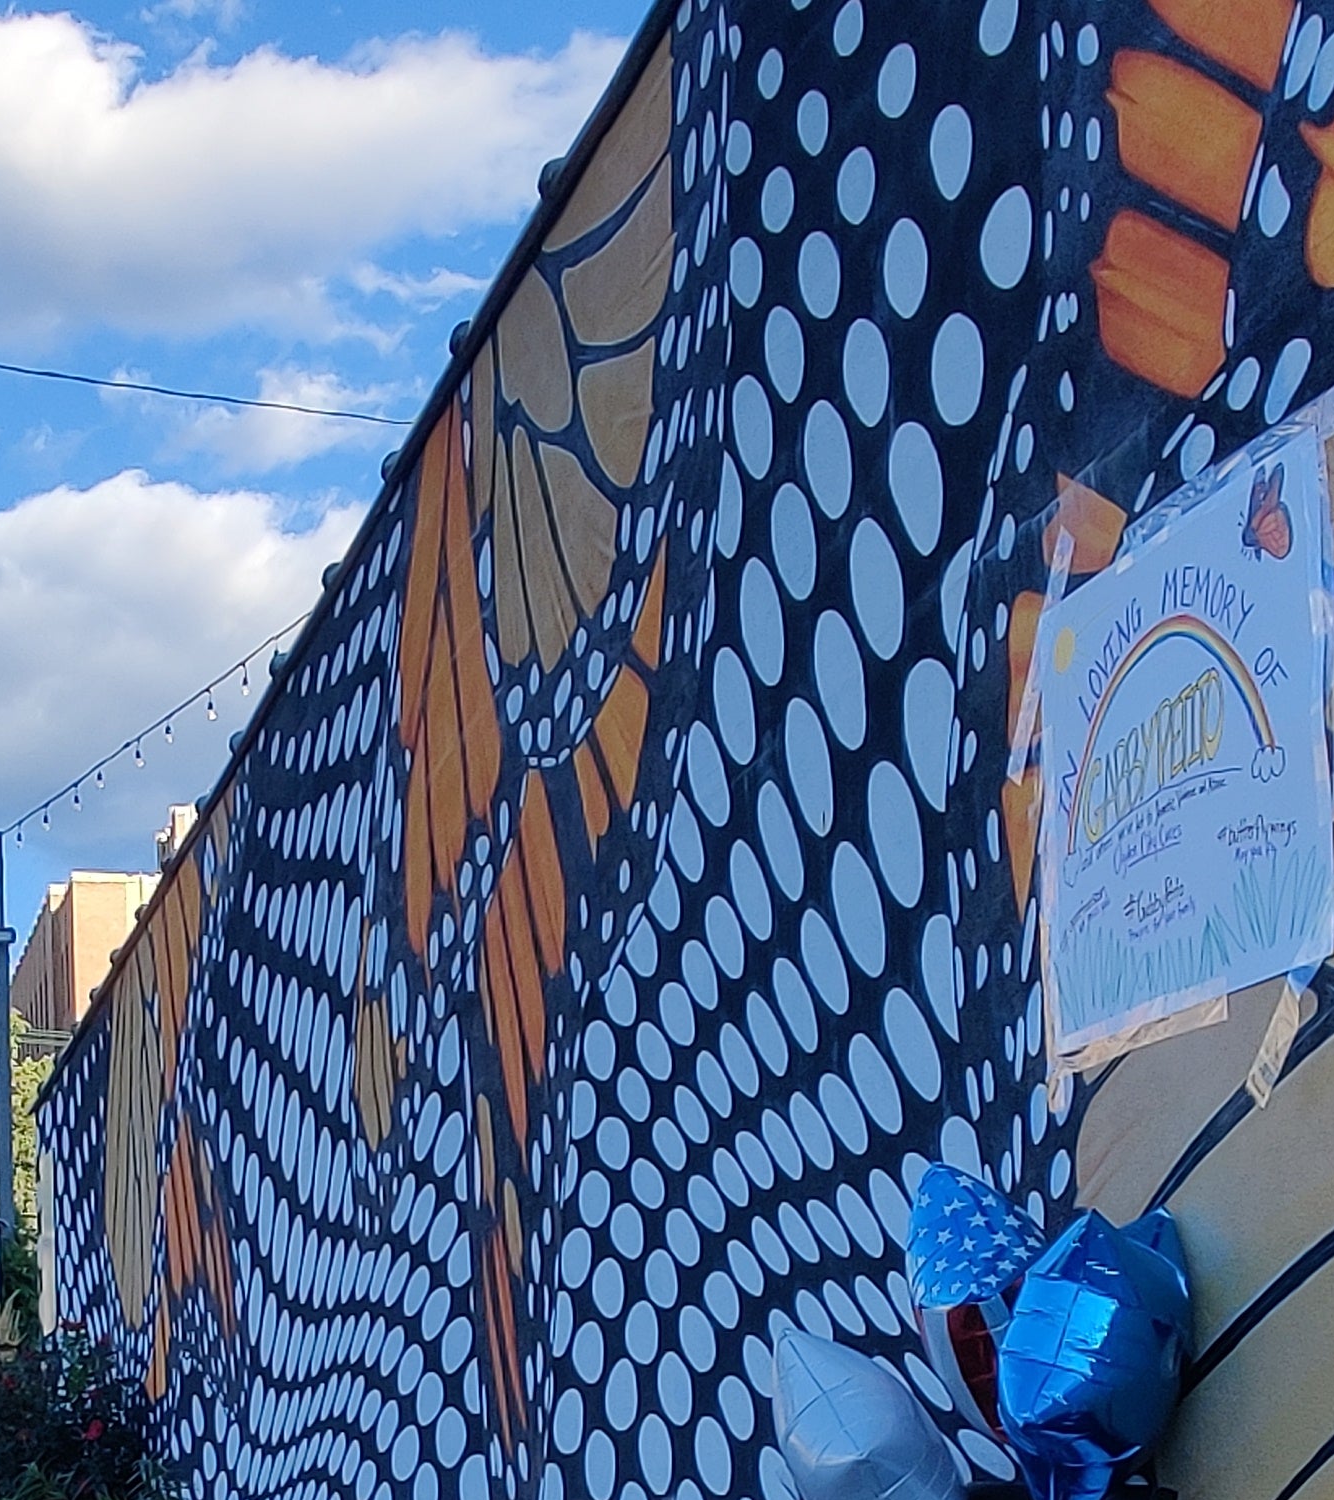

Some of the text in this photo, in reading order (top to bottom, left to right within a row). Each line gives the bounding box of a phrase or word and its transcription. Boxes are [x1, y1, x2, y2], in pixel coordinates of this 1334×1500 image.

[1058, 750, 1079, 816] IN
[1078, 598, 1144, 723] LOVING
[1161, 566, 1256, 641] MEMORY
[1255, 647, 1290, 688] OF
[1083, 716, 1158, 843] GABBY
